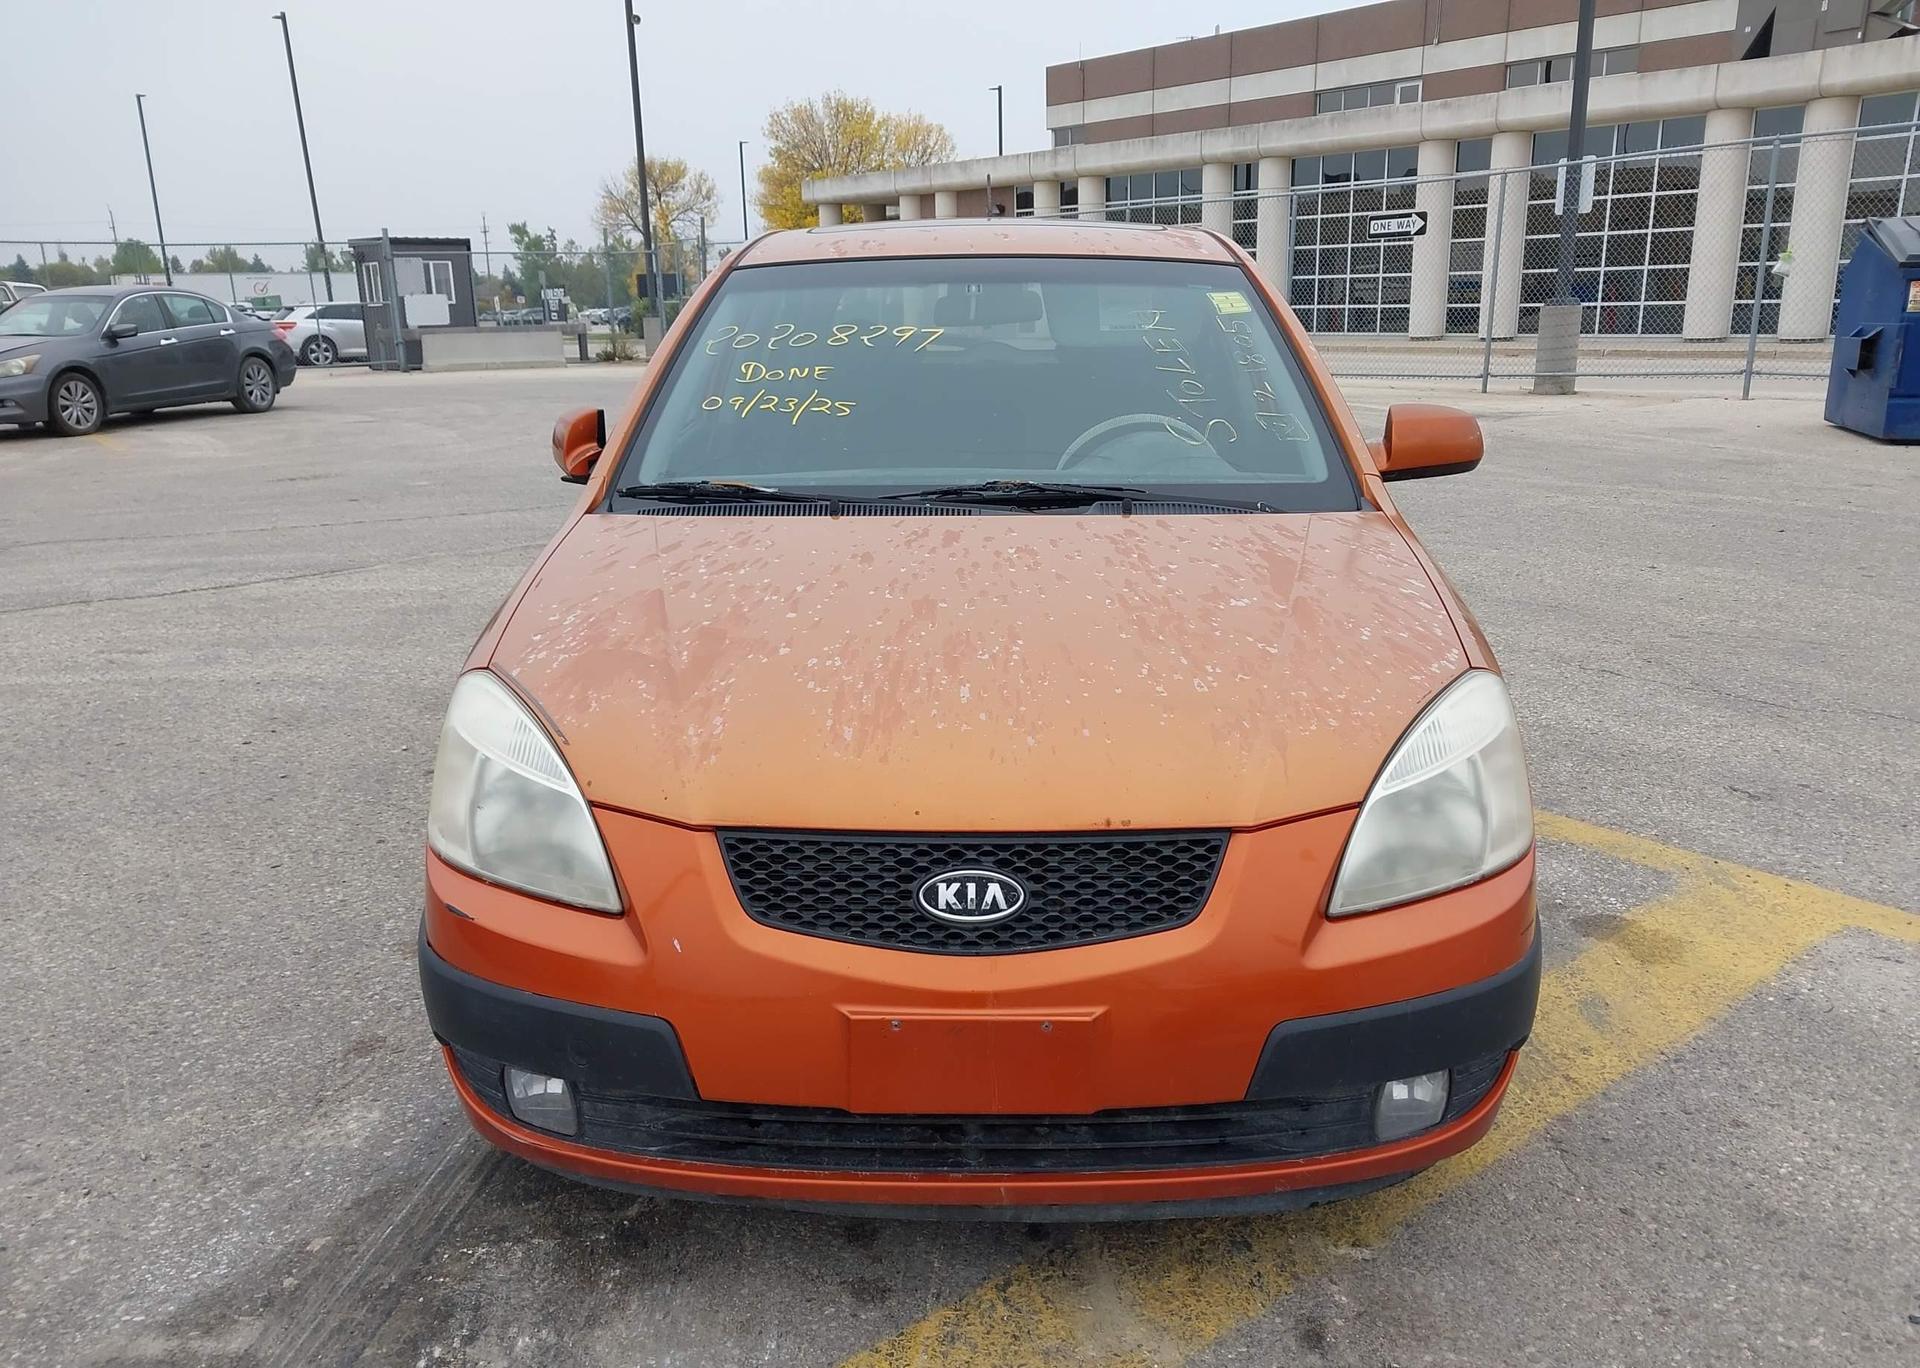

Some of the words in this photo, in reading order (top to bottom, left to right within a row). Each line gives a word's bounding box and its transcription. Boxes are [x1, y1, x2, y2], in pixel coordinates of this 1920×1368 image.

[1372, 221, 1392, 232] ONE
[1396, 219, 1417, 230] WAY
[706, 323, 944, 355] 20208297
[735, 361, 835, 383] DONE
[1141, 309, 1238, 446] STOLEN
[701, 389, 857, 426] 09/23/25
[936, 882, 1007, 910] KIA
